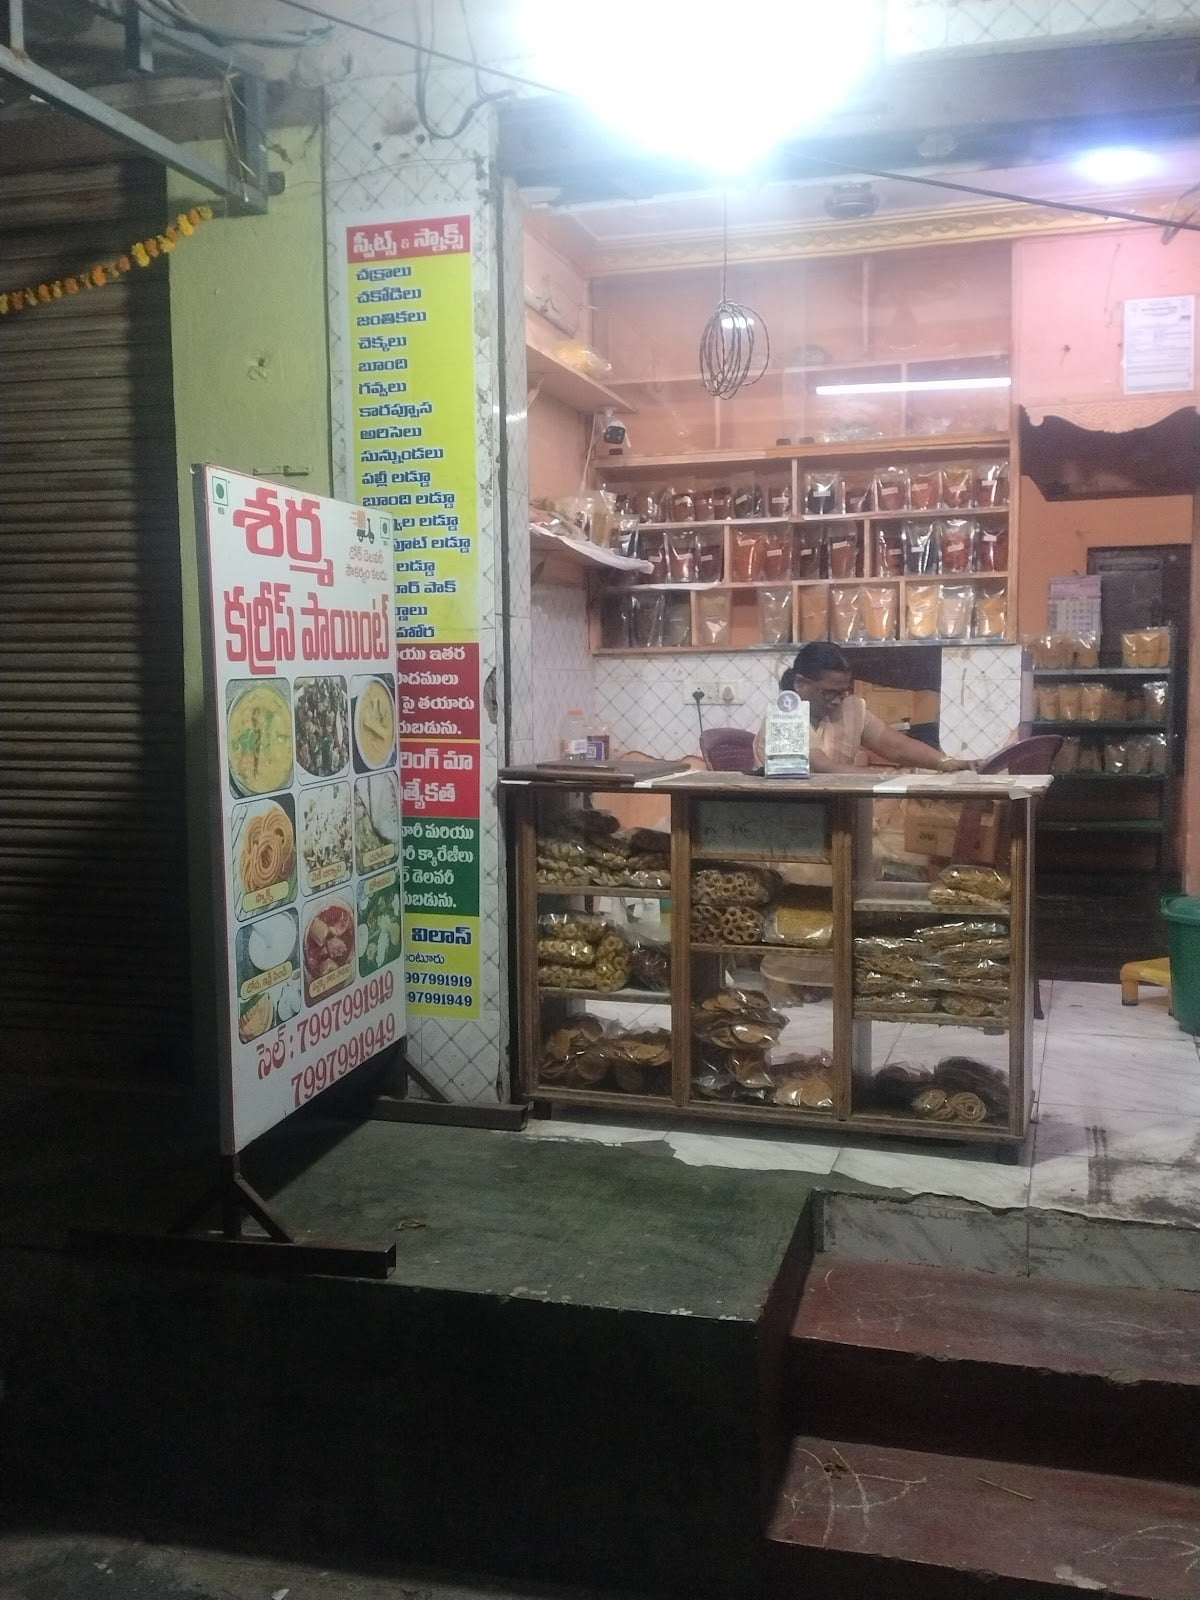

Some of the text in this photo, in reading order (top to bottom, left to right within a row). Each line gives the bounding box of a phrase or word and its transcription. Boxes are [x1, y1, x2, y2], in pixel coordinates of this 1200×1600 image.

[356, 266, 412, 281] చక్రాలు
[358, 335, 407, 352] చెక్కలు
[358, 381, 407, 397] గవ్వలు
[360, 426, 422, 440] అరిసెలు
[361, 447, 444, 464] సున్నుండలు
[391, 470, 431, 488] లడ్డూ
[415, 491, 455, 509] లడ్డూ
[419, 514, 458, 531] లడ్డూ
[233, 486, 334, 587] శర్మ
[431, 536, 471, 553] లడ్డూ
[424, 580, 457, 594] పాక్
[300, 592, 390, 661] పాయింట్
[429, 646, 466, 661] ఇతర
[418, 696, 475, 710] తయారు
[443, 750, 473, 770] మా
[425, 824, 474, 840] మరియు
[412, 926, 472, 945] విలాస్
[297, 970, 394, 1054] 7997991919
[291, 1013, 395, 1108] 7997991949
